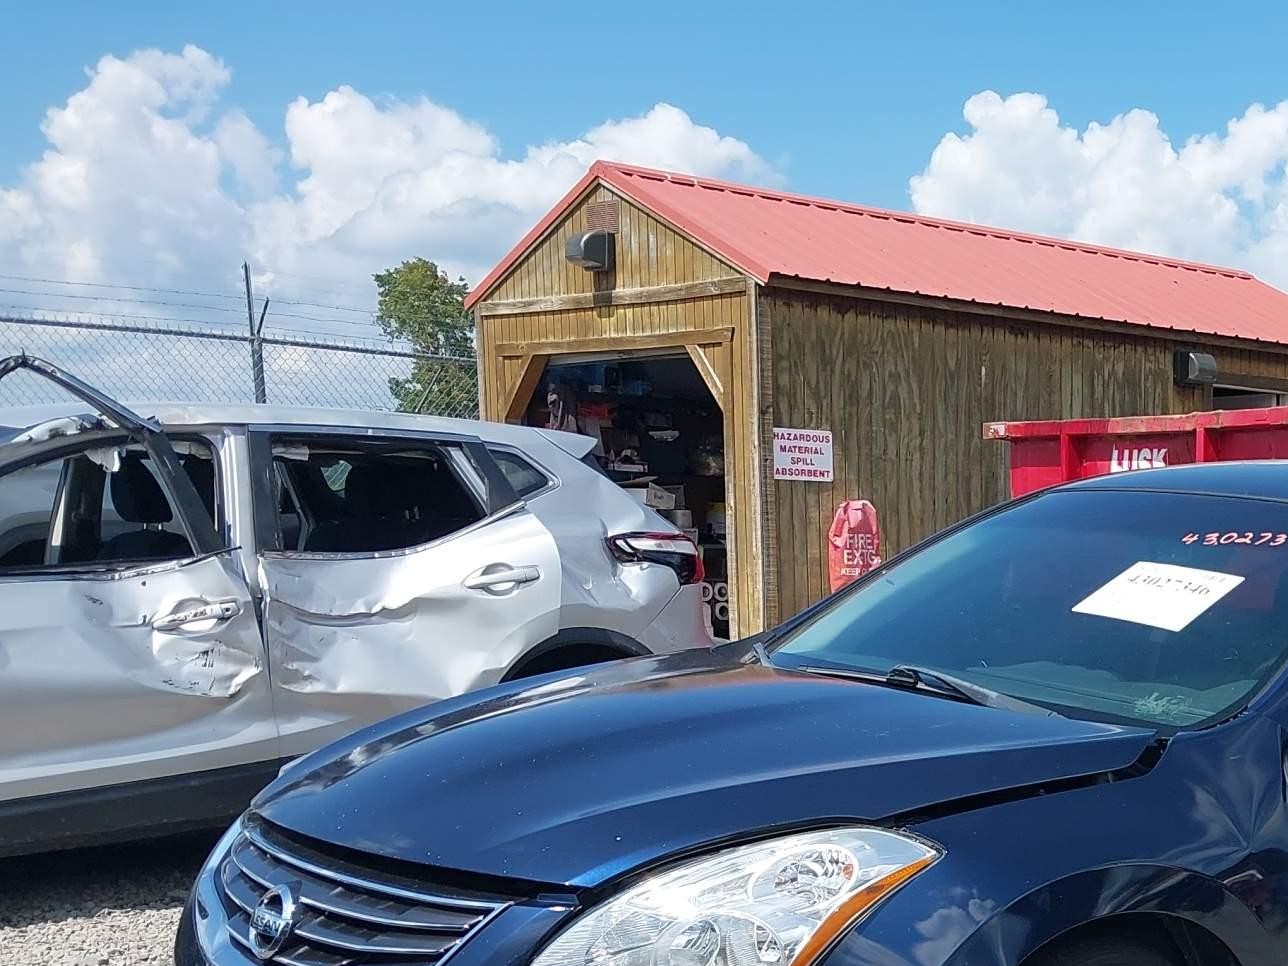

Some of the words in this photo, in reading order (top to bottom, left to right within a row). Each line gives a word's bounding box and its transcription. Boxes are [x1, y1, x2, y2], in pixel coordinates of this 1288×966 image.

[773, 432, 831, 444] HAZARDOUS
[779, 445, 825, 455] MATERIAL
[790, 457, 815, 466] SPILL
[775, 468, 831, 478] ABSORBENT
[846, 534, 873, 549] FIRE
[840, 567, 861, 576] KEEP
